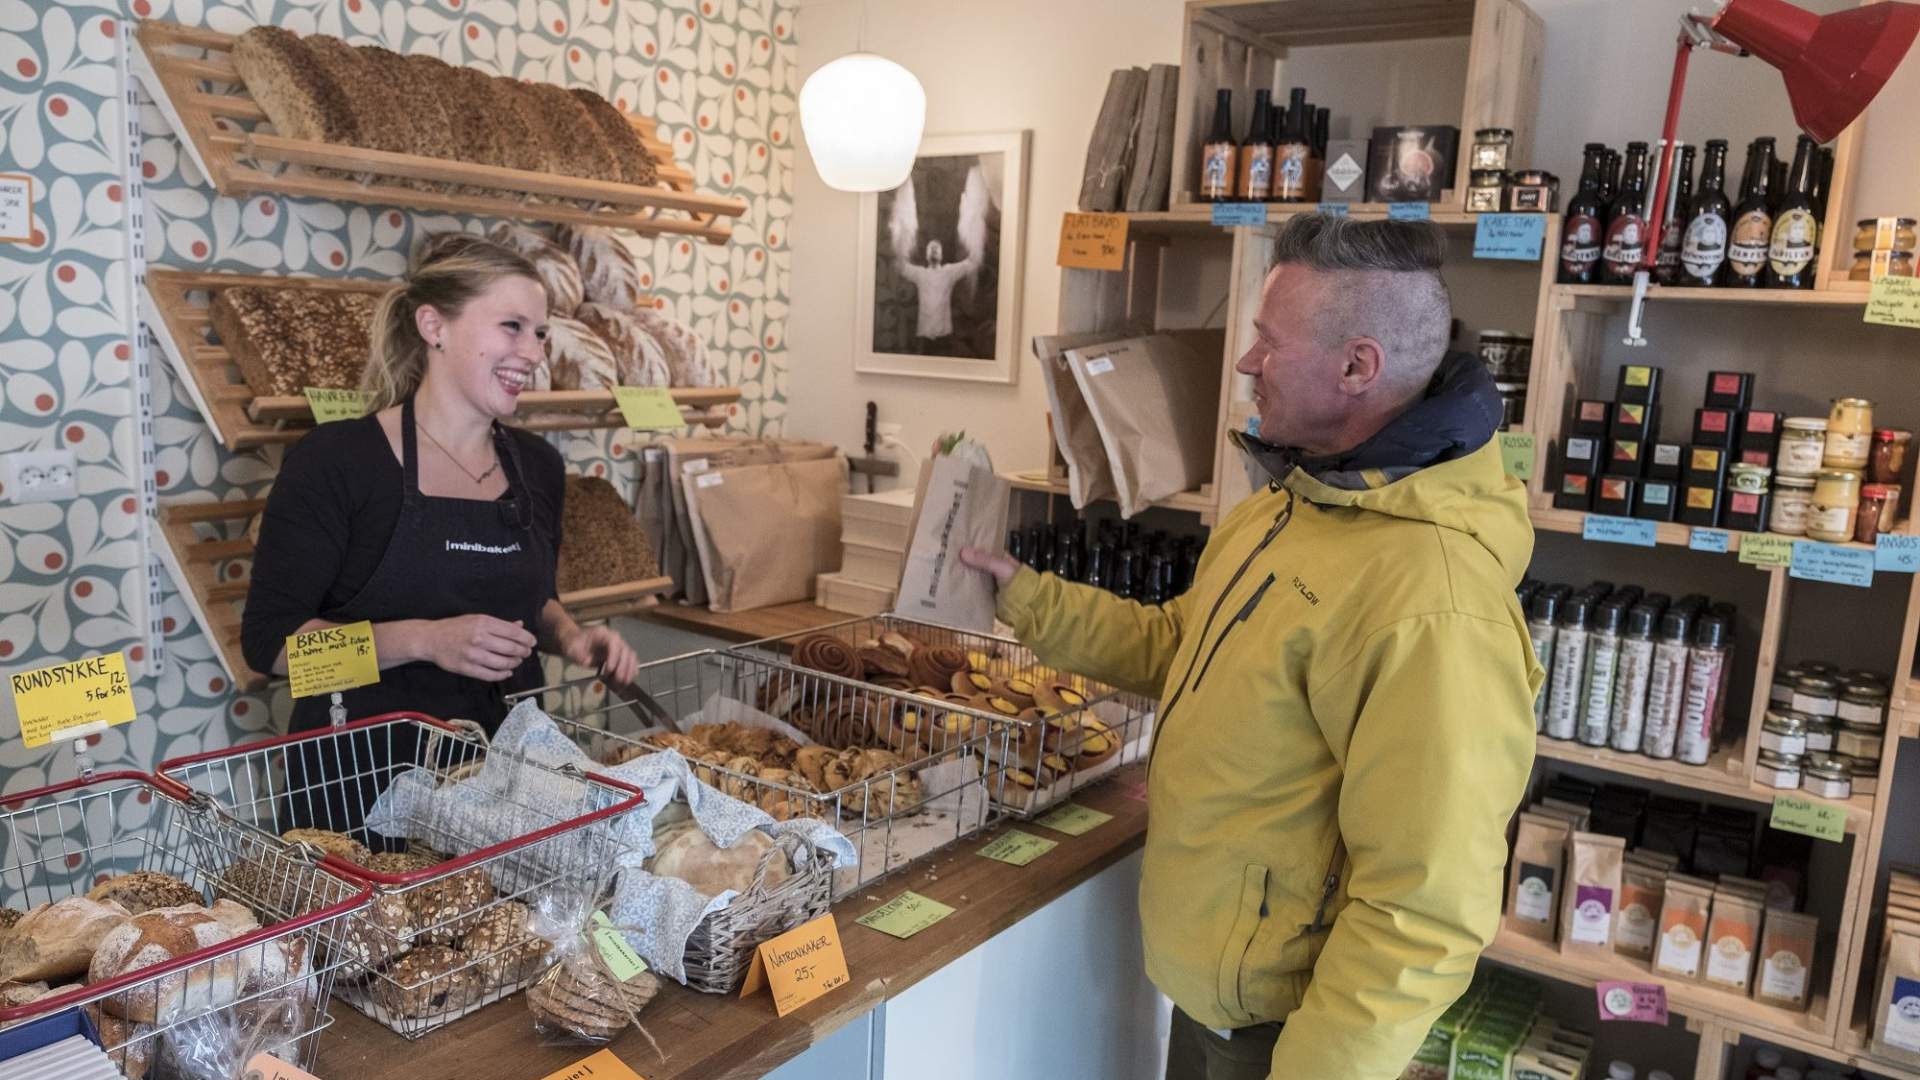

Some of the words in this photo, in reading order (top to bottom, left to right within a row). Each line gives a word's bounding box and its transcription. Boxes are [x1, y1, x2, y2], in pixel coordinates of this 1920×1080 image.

[296, 629, 347, 649] BRIKS
[12, 657, 110, 694] RUNDSTYKKE
[86, 690, 94, 702] 5
[95, 687, 108, 699] for
[768, 935, 833, 970] NATRONKAKER
